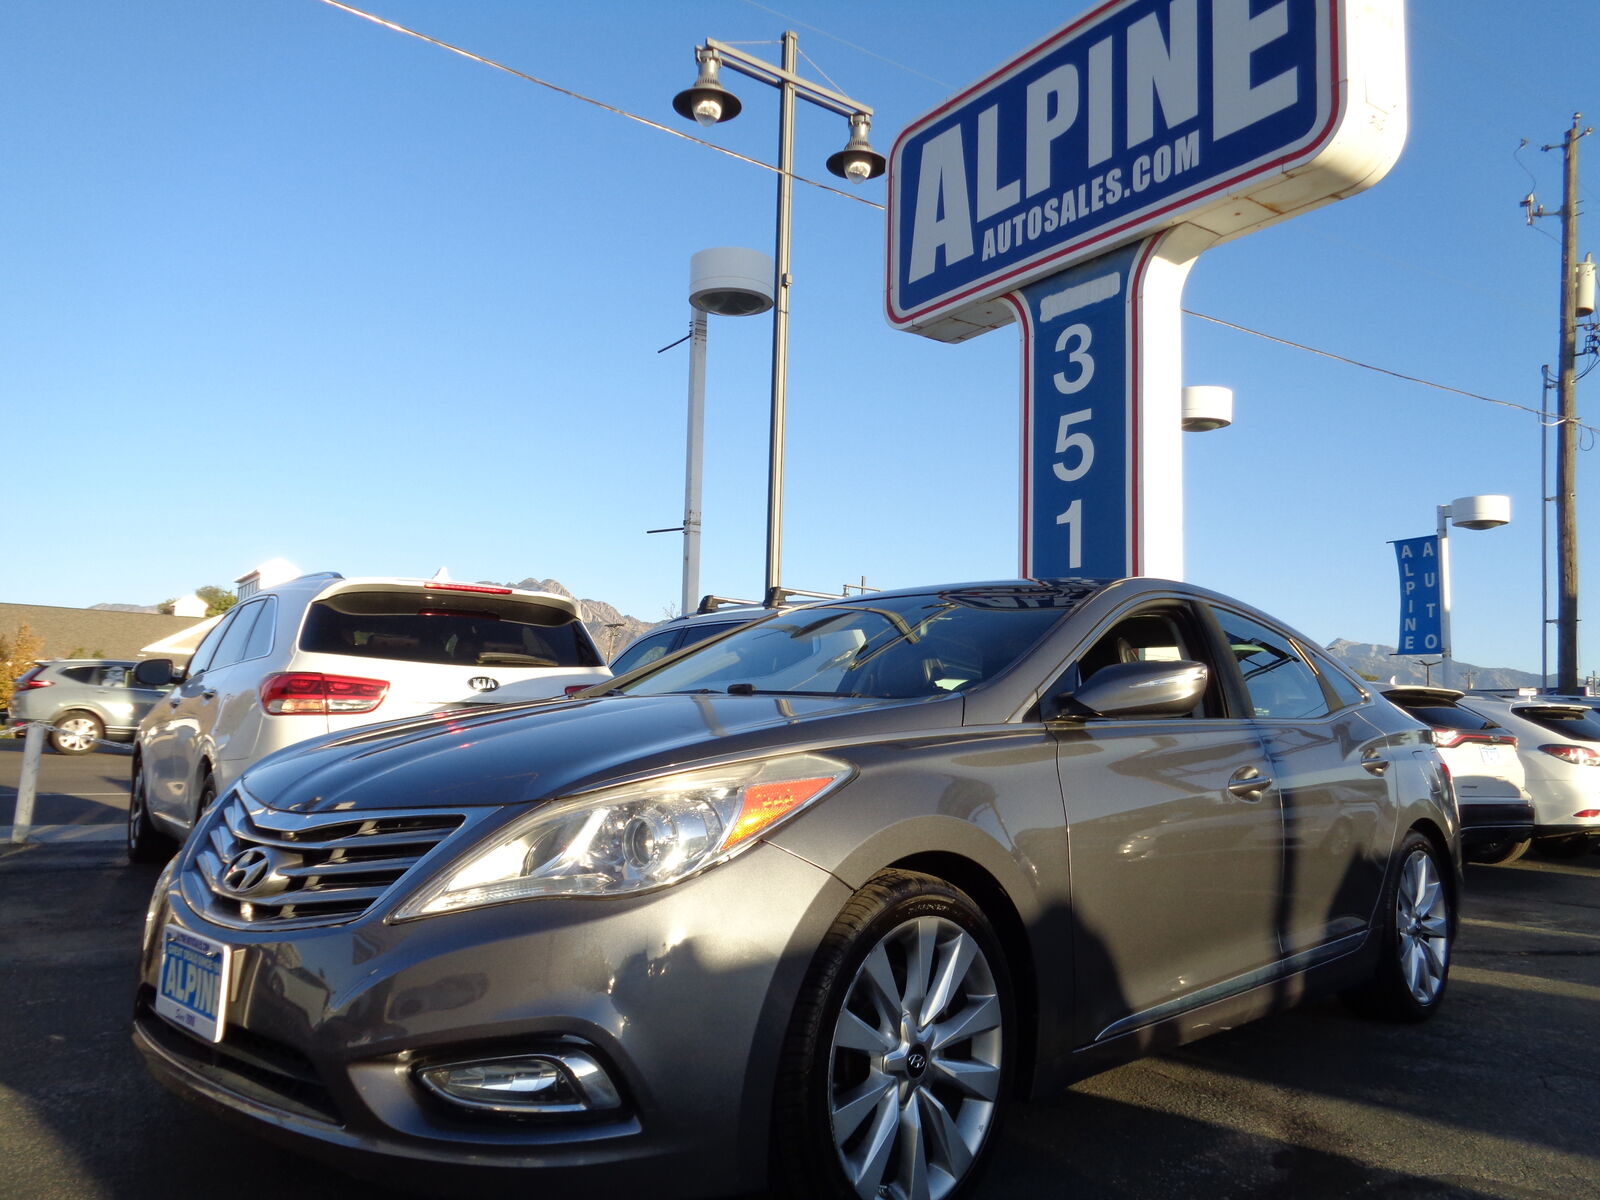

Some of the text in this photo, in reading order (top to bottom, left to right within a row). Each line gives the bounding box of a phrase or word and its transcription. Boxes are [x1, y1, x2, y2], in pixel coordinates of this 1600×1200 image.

[908, 0, 1298, 284] ALPINE
[982, 129, 1200, 262] AUTOSALES.COM
[1401, 544, 1416, 650] ALPINE
[1422, 542, 1438, 649] AUTO
[471, 677, 497, 690] KIA
